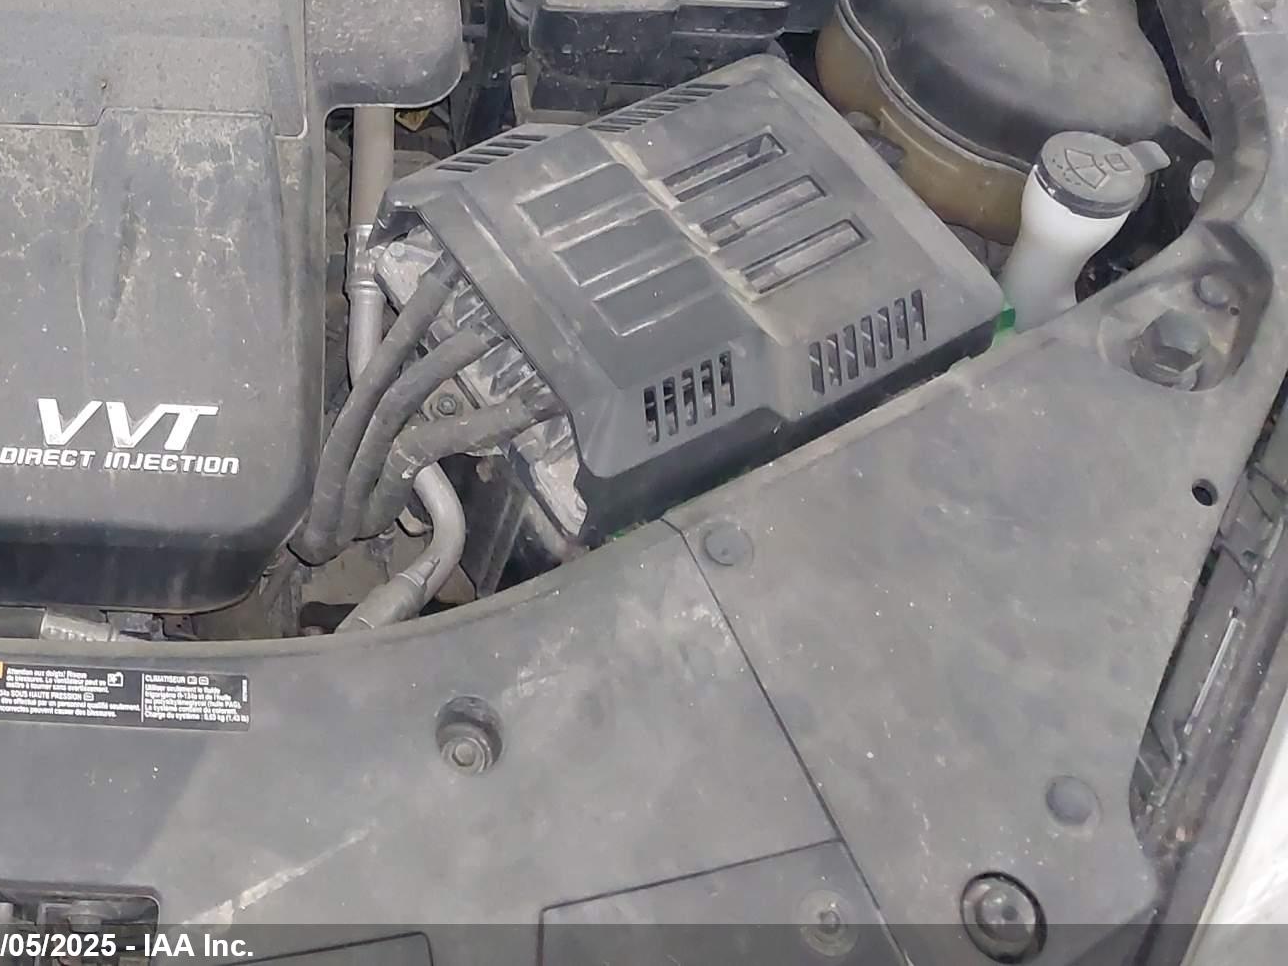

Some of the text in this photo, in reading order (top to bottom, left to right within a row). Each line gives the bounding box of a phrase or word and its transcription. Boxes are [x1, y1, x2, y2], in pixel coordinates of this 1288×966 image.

[37, 398, 219, 450] VVT
[0, 447, 239, 474] DIRECT INJECTION
